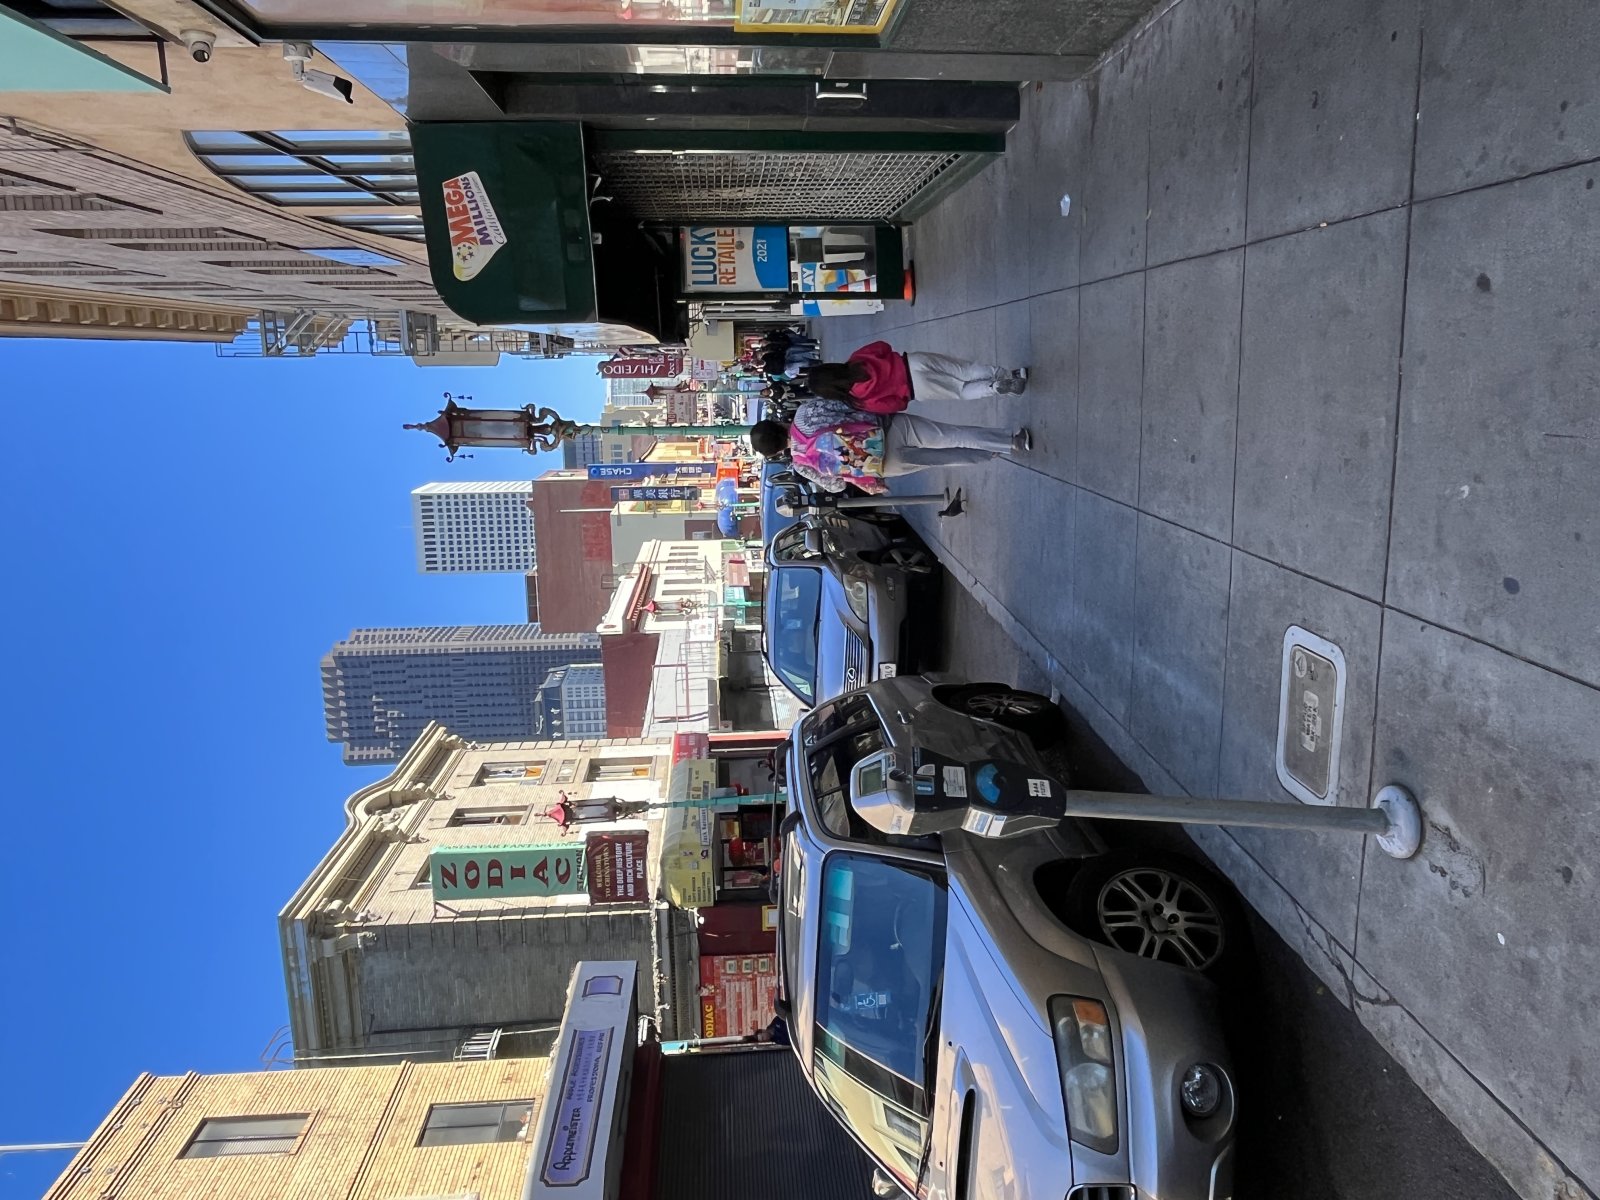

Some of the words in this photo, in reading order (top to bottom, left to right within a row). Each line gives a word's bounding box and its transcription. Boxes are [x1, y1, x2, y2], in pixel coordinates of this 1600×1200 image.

[444, 178, 478, 246] MEGA
[461, 176, 493, 245] MILLIONS
[479, 196, 504, 244] California
[717, 228, 736, 285] RETAILE
[757, 239, 767, 262] 2021
[668, 414, 675, 422] NO
[440, 856, 571, 889] ZODIAC
[576, 850, 584, 891] STATION
[616, 870, 624, 884] DEEP
[605, 888, 611, 898] TO
[705, 1005, 714, 1037] ODIAC
